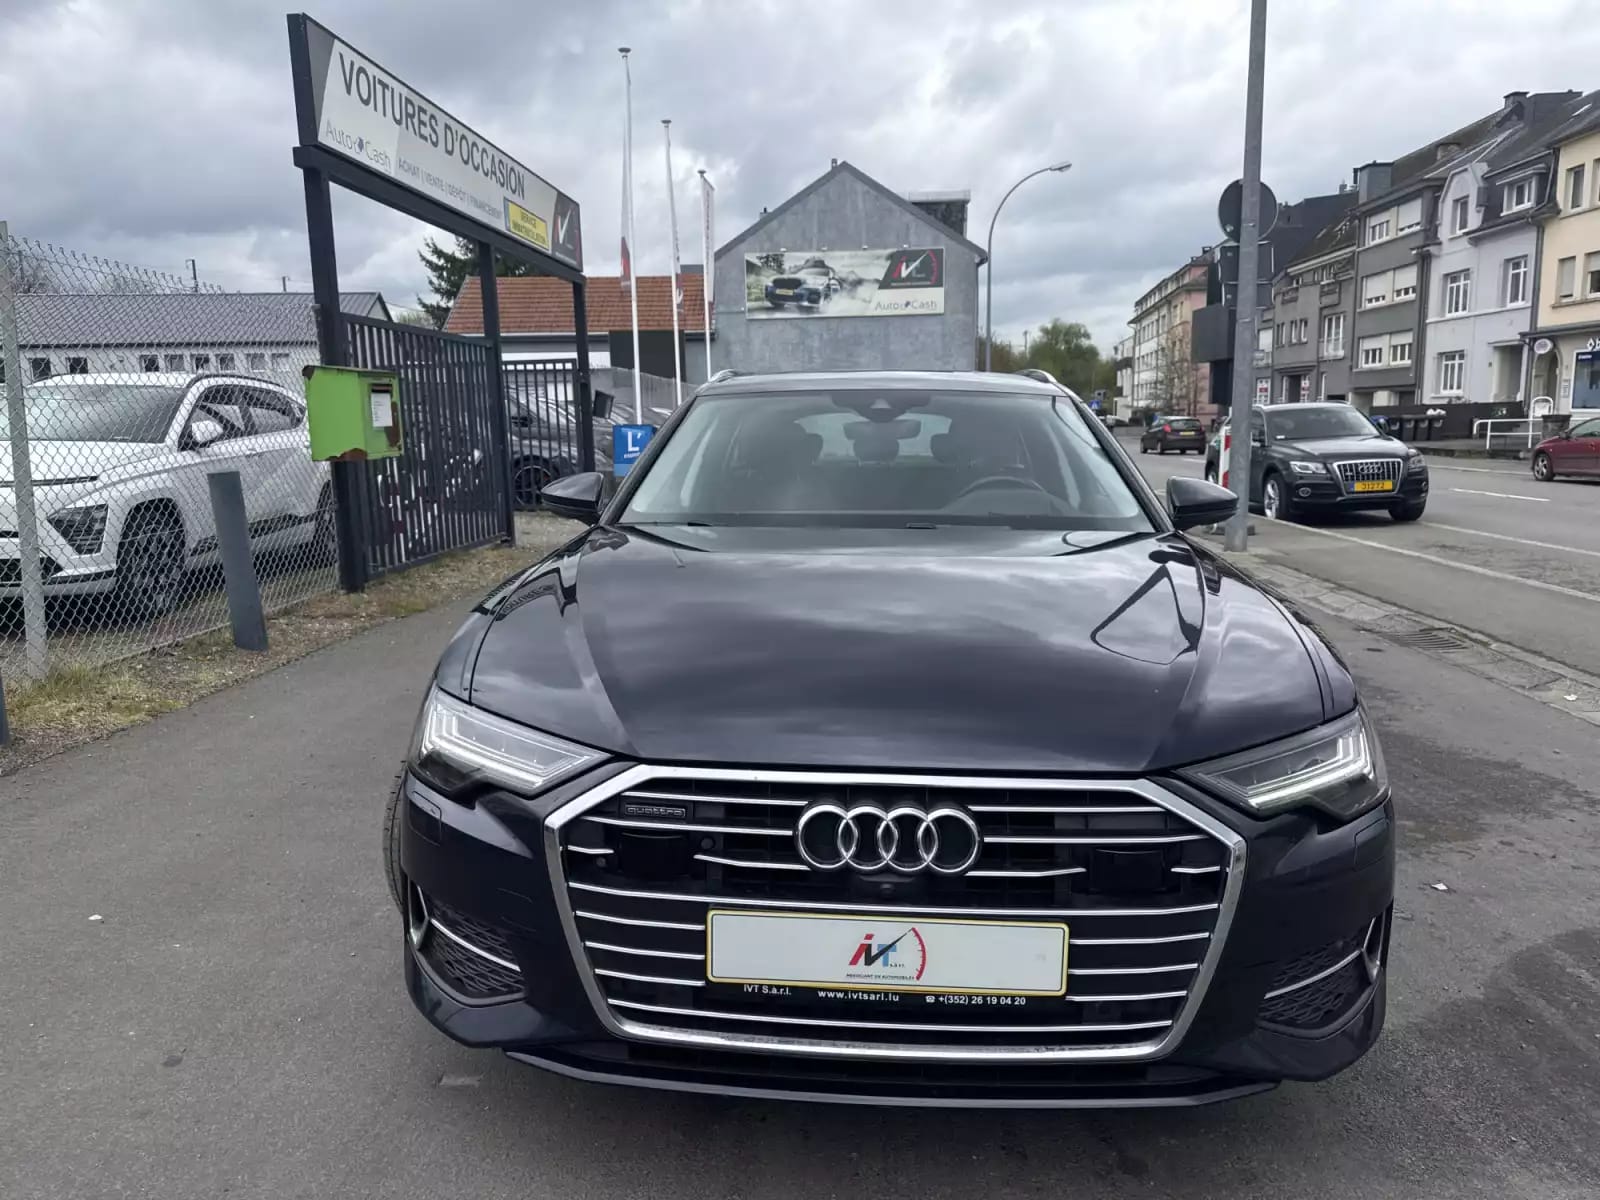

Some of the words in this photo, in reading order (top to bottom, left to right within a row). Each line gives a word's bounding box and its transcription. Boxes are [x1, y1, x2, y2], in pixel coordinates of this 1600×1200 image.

[339, 52, 439, 149] VOITURES
[444, 121, 525, 200] D'OCCASION
[627, 806, 683, 817] quattro
[743, 984, 759, 993] IVT
[817, 990, 899, 1002] www.ivtsarl.lu
[938, 995, 969, 1005] +(352)
[971, 996, 983, 1005] 26
[986, 997, 998, 1005] 19
[1000, 997, 1012, 1005] 04
[1014, 997, 1026, 1005] 20
